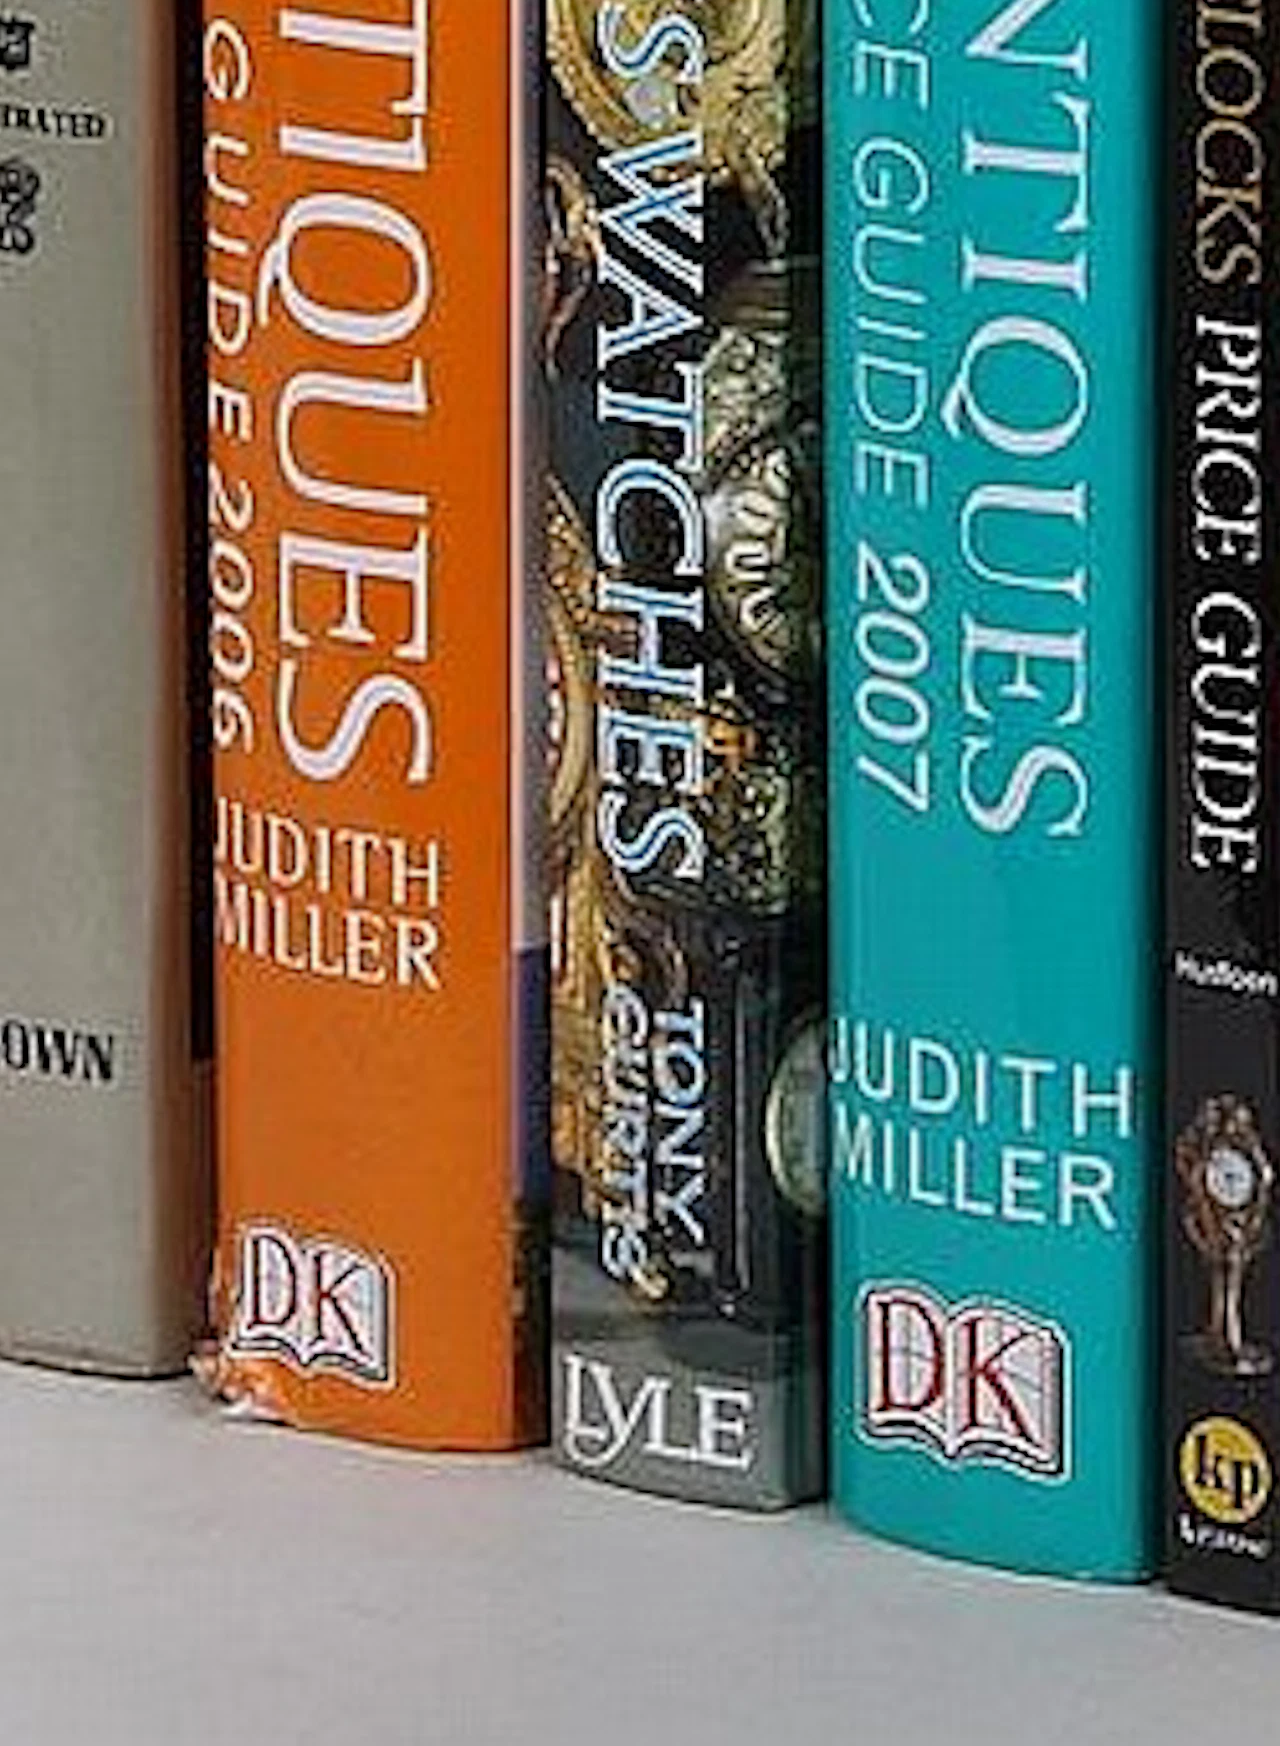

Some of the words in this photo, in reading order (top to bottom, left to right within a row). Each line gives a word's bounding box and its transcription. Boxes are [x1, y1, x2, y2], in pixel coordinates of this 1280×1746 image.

[203, 16, 253, 444] GUIDE
[851, 136, 931, 509] GUIDE
[595, 134, 705, 880] WATCHES
[1195, 314, 1263, 566] PRICE
[207, 462, 256, 756] 2006
[853, 540, 931, 813] 2007
[1190, 591, 1262, 875] GUIDE
[600, 982, 652, 1286] CURTIS
[652, 995, 708, 1249] TONY
[828, 1016, 1135, 1140] JUDITH
[831, 1100, 1118, 1232] MILLER
[246, 1232, 366, 1356] DK
[562, 1352, 756, 1470] LYLE
[870, 1298, 1052, 1456] DK
